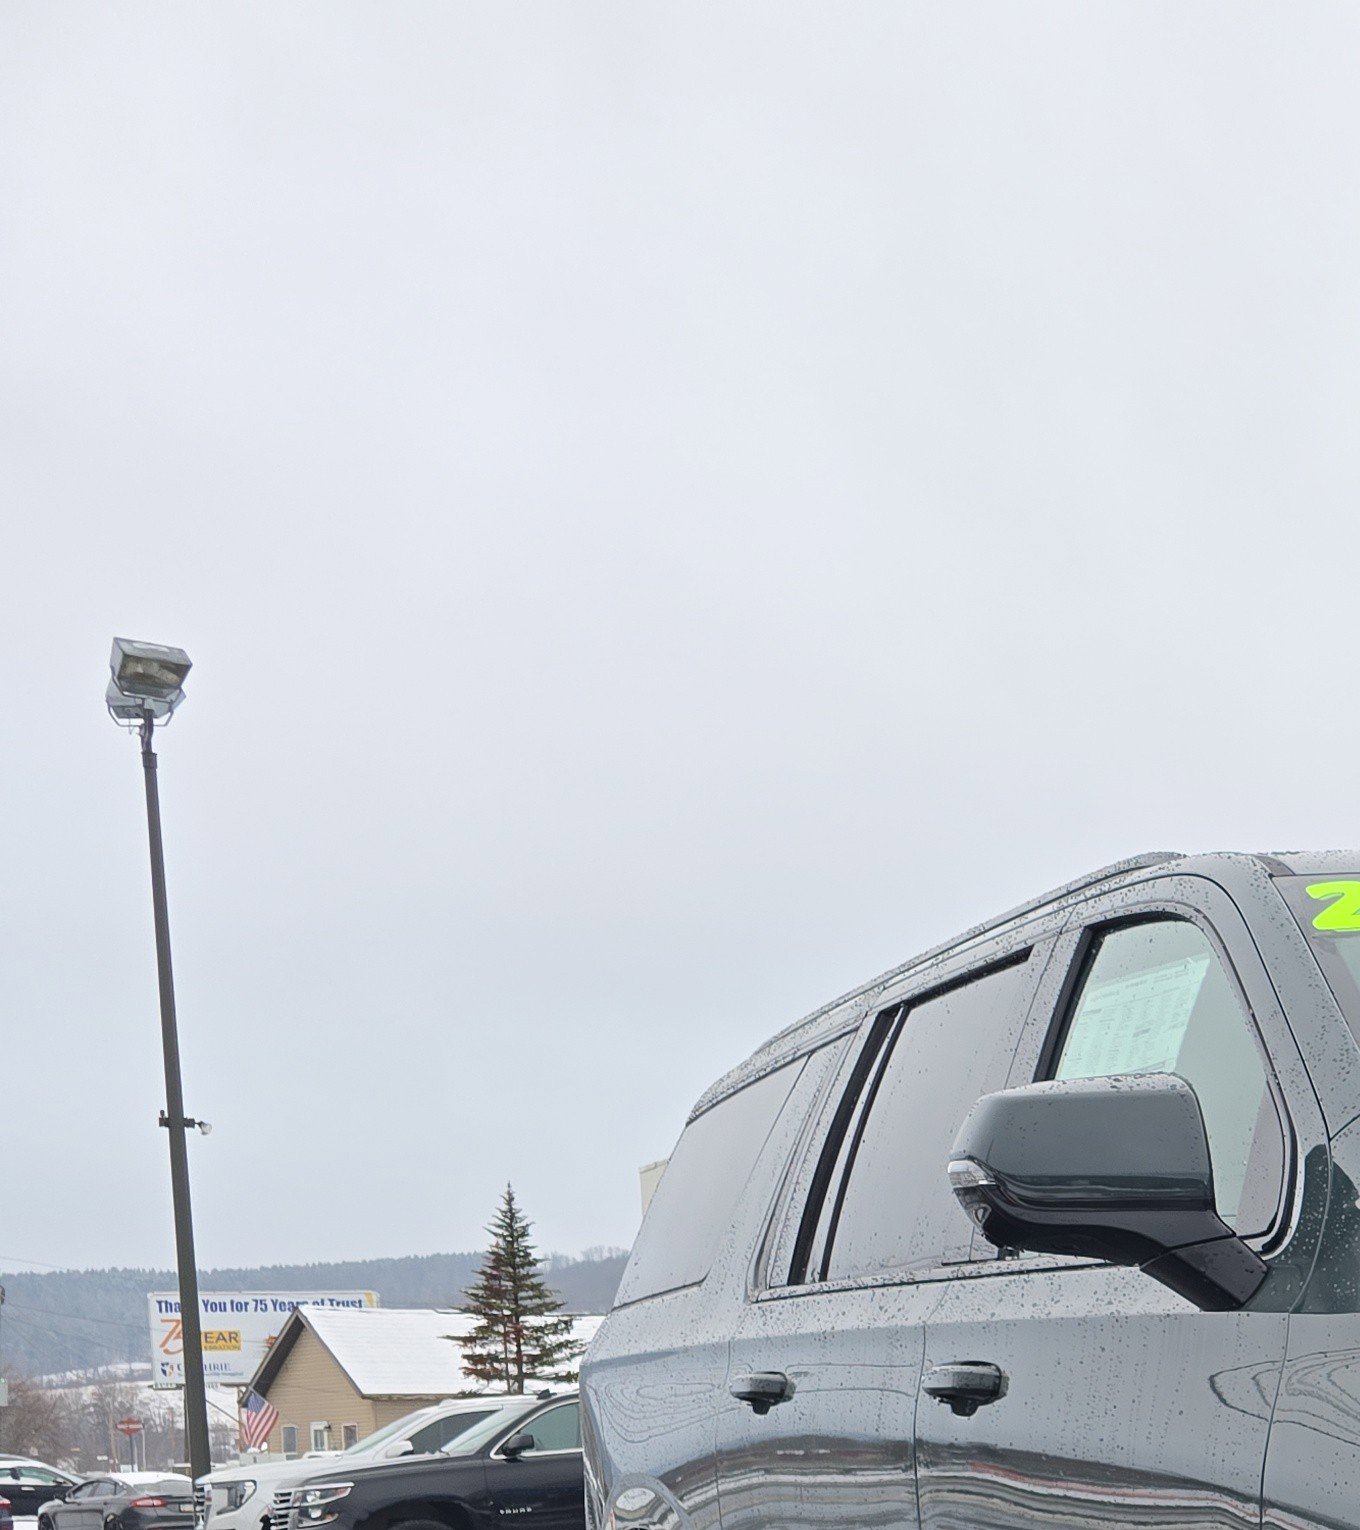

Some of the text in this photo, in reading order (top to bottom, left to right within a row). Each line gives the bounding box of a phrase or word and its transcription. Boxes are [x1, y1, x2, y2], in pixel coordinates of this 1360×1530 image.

[156, 1299, 182, 1314] Tha
[202, 1299, 227, 1313] You
[230, 1299, 250, 1313] for
[252, 1298, 268, 1313] 75
[204, 1331, 239, 1344] EAR
